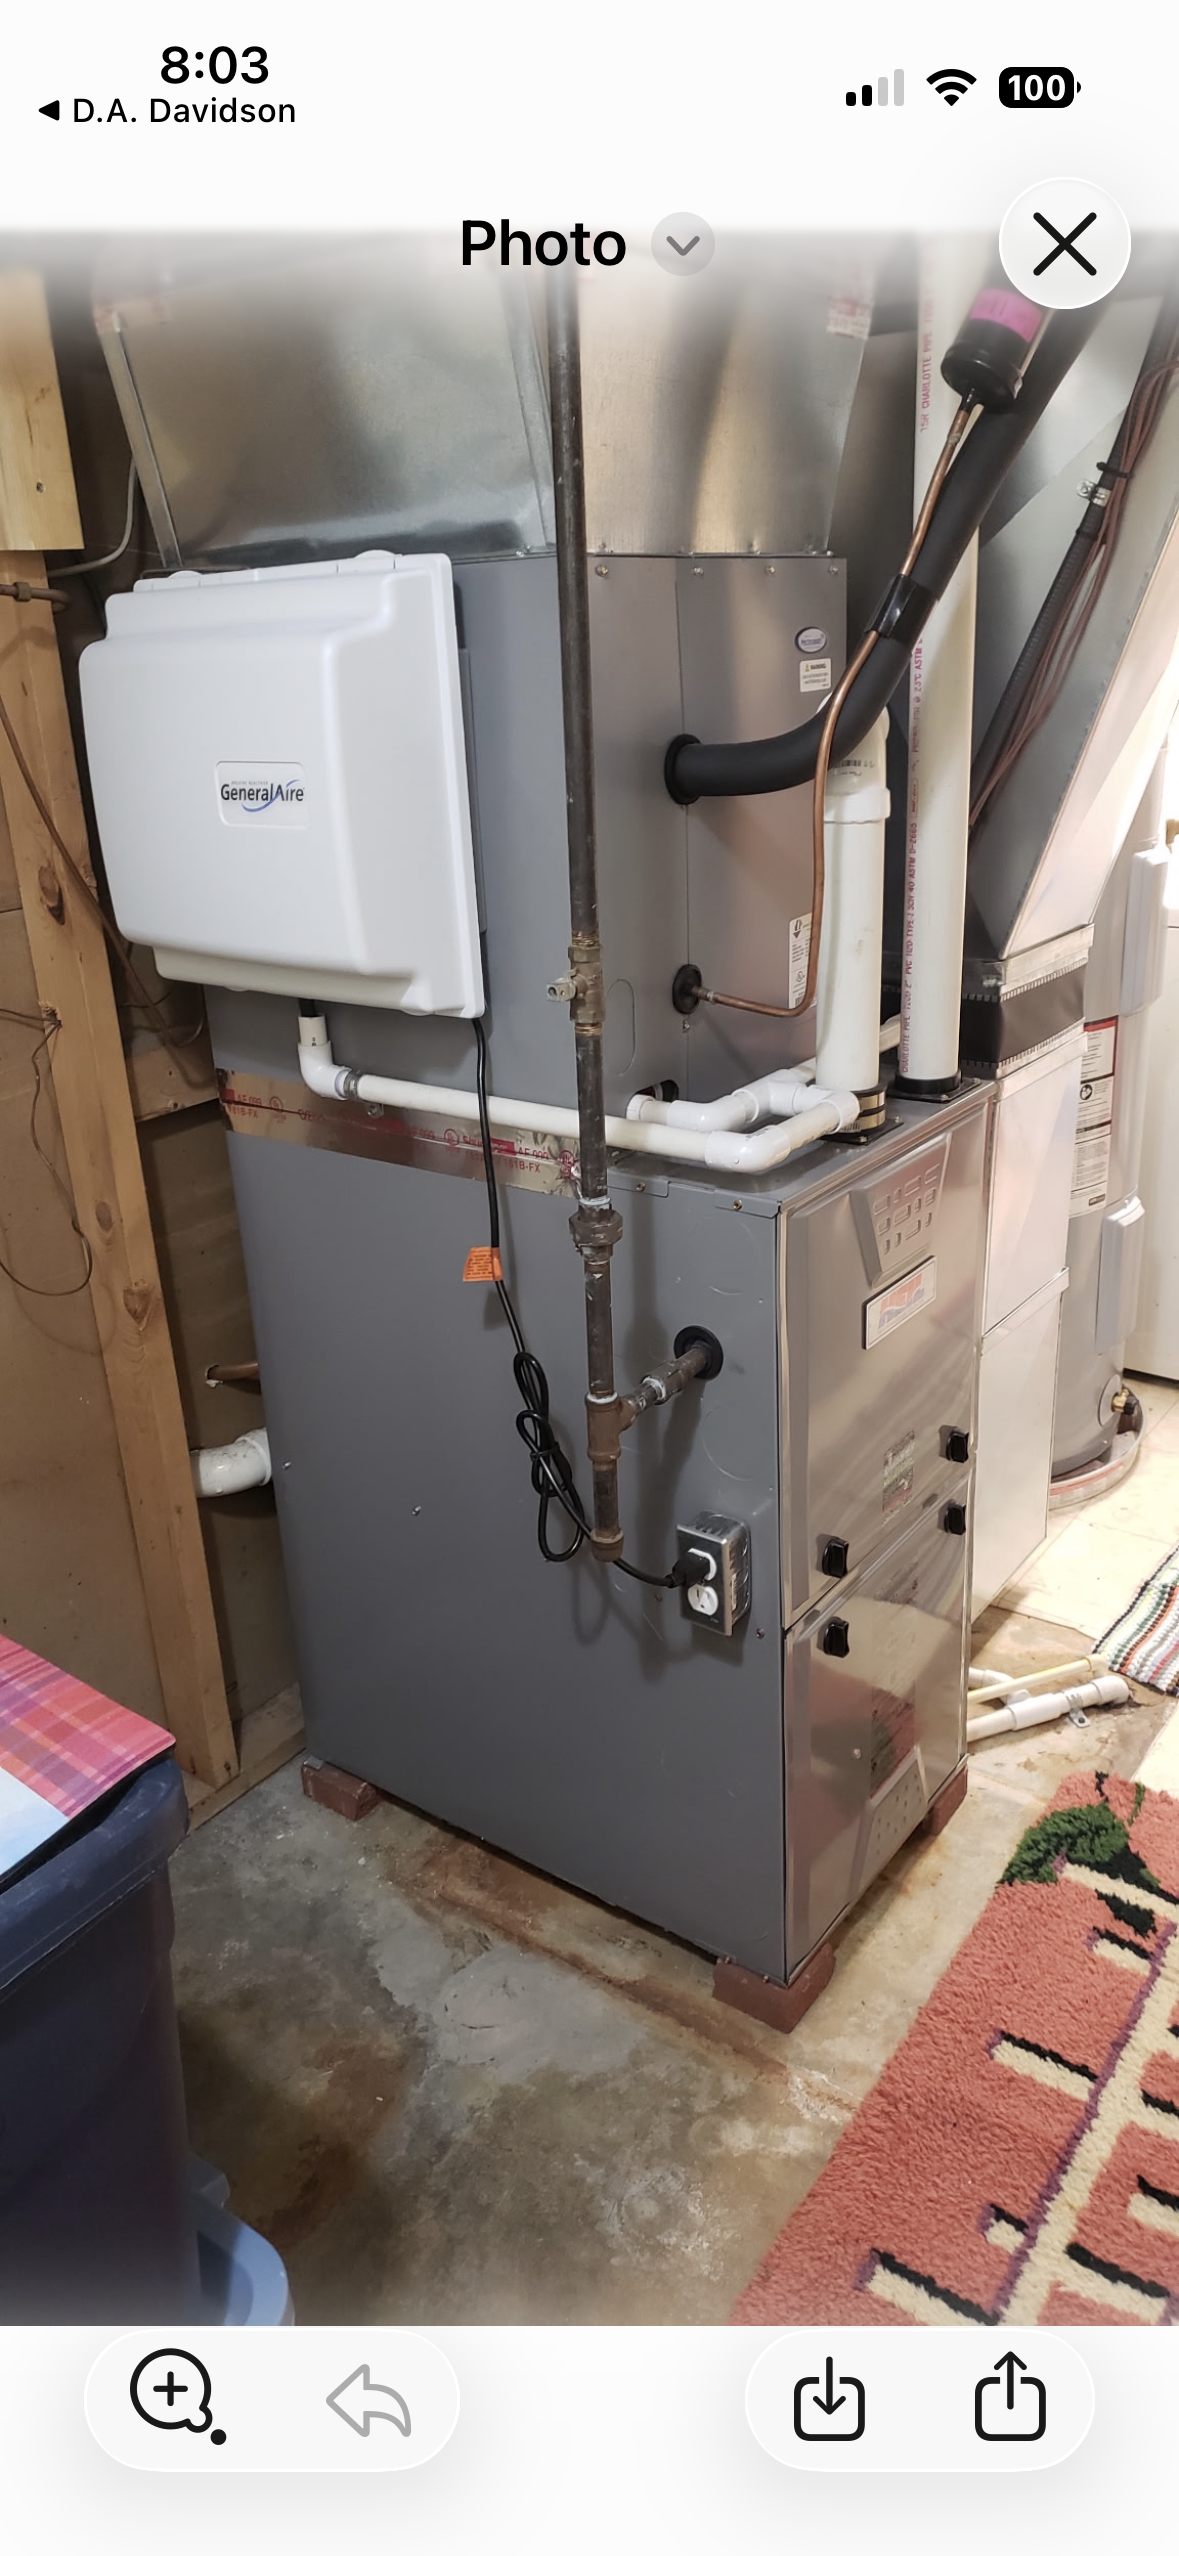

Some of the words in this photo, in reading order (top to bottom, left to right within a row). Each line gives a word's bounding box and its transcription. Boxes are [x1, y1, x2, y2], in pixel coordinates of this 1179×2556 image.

[922, 355, 932, 409] CHARLOTTE
[914, 647, 923, 670] ASTM
[908, 857, 917, 879] ASTM
[908, 881, 916, 892] 40
